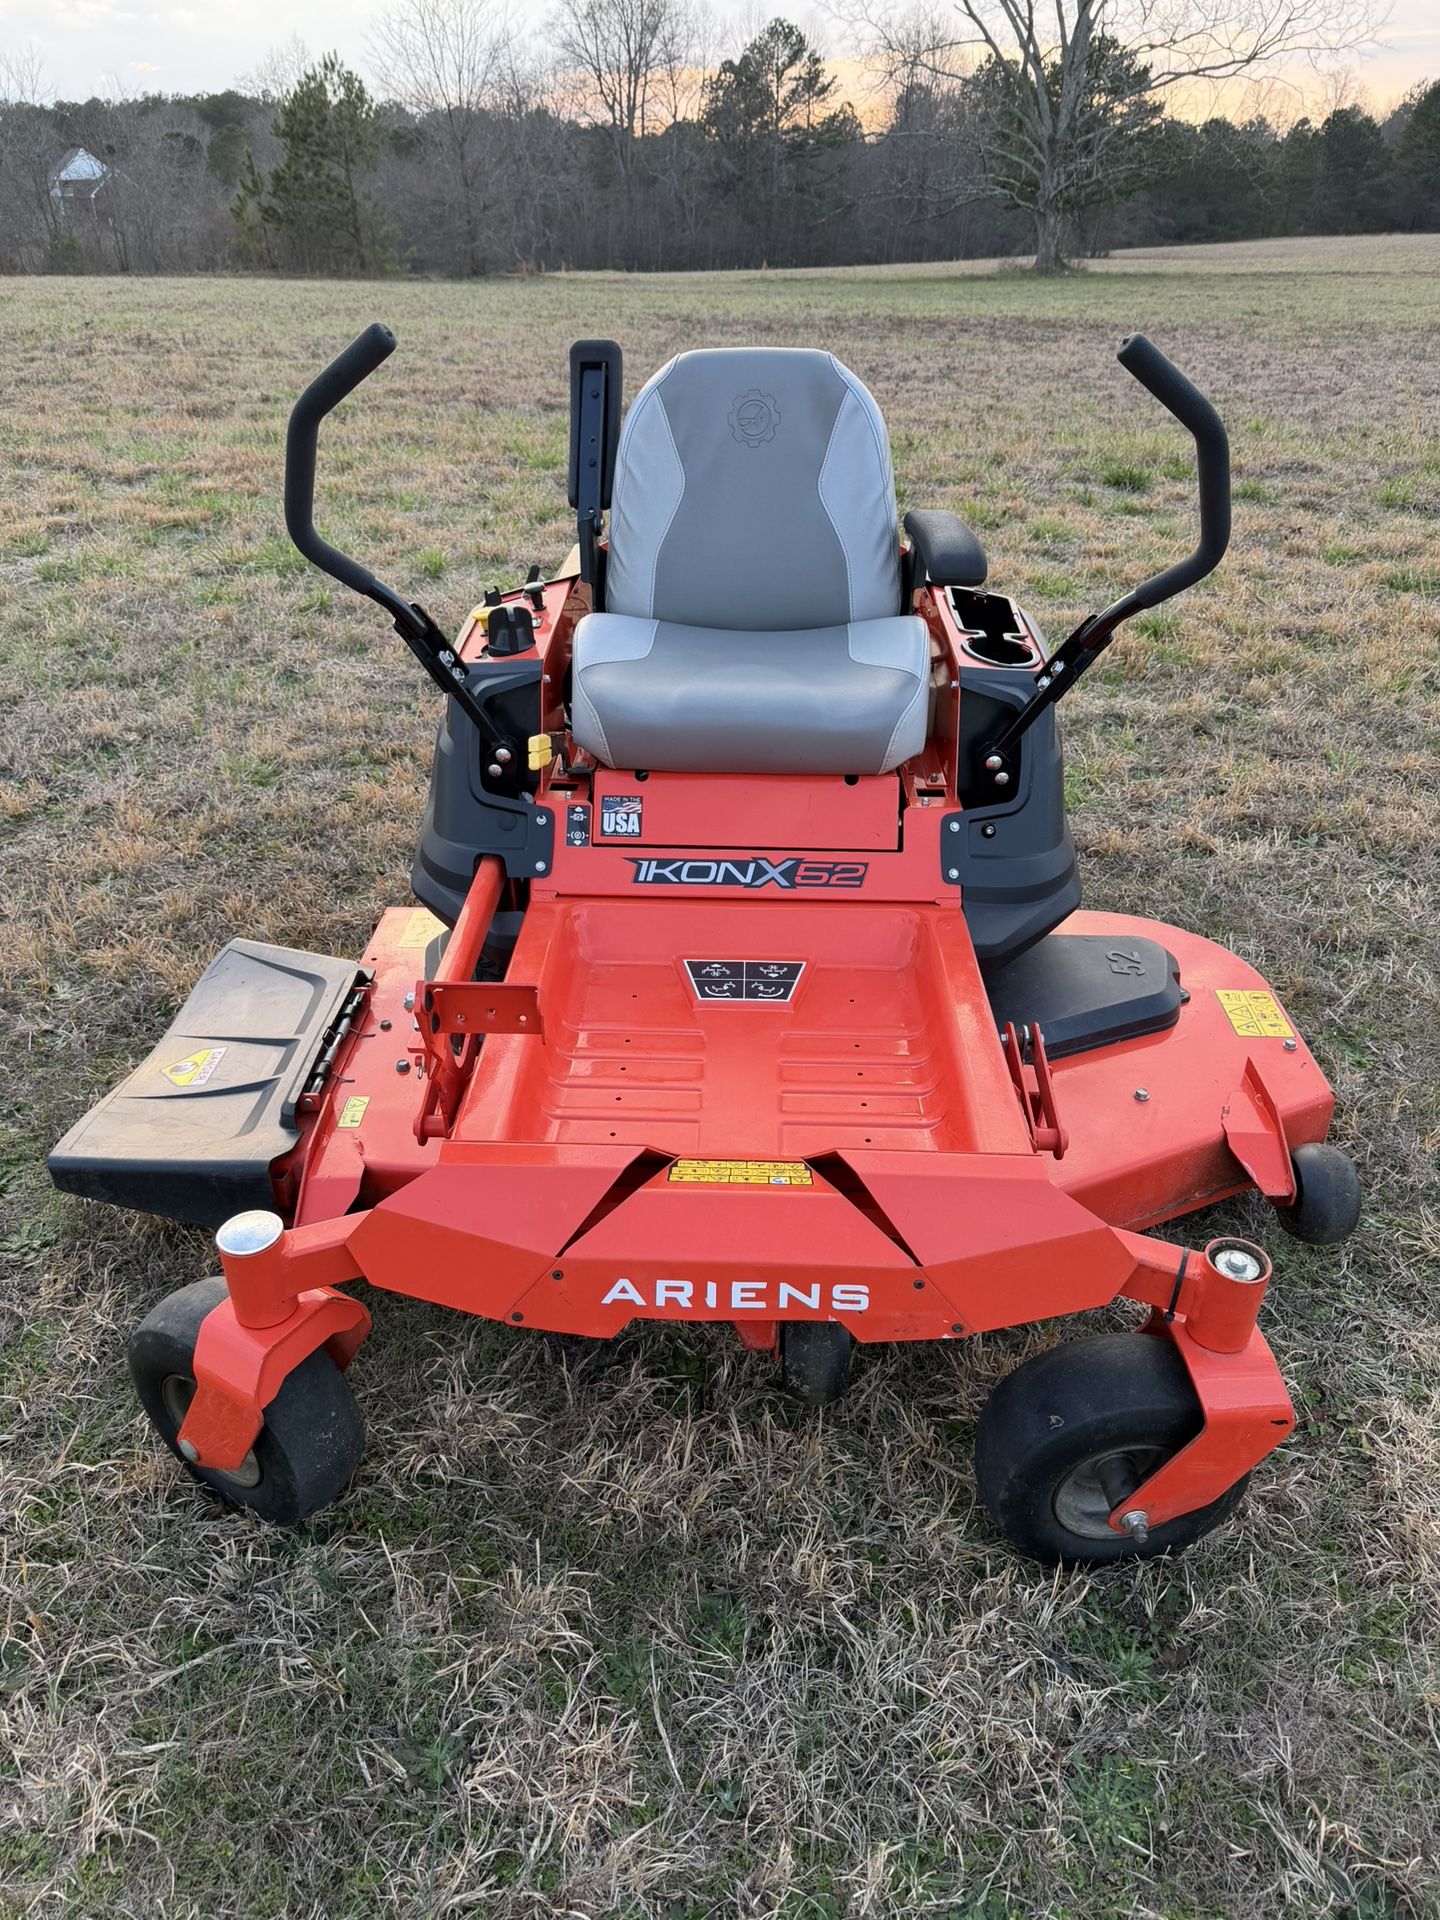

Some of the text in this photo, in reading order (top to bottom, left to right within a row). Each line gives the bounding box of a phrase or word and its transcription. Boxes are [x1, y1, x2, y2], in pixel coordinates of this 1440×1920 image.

[603, 812, 640, 833] USA
[1104, 950, 1146, 977] 52
[600, 1278, 871, 1312] ARIENS
